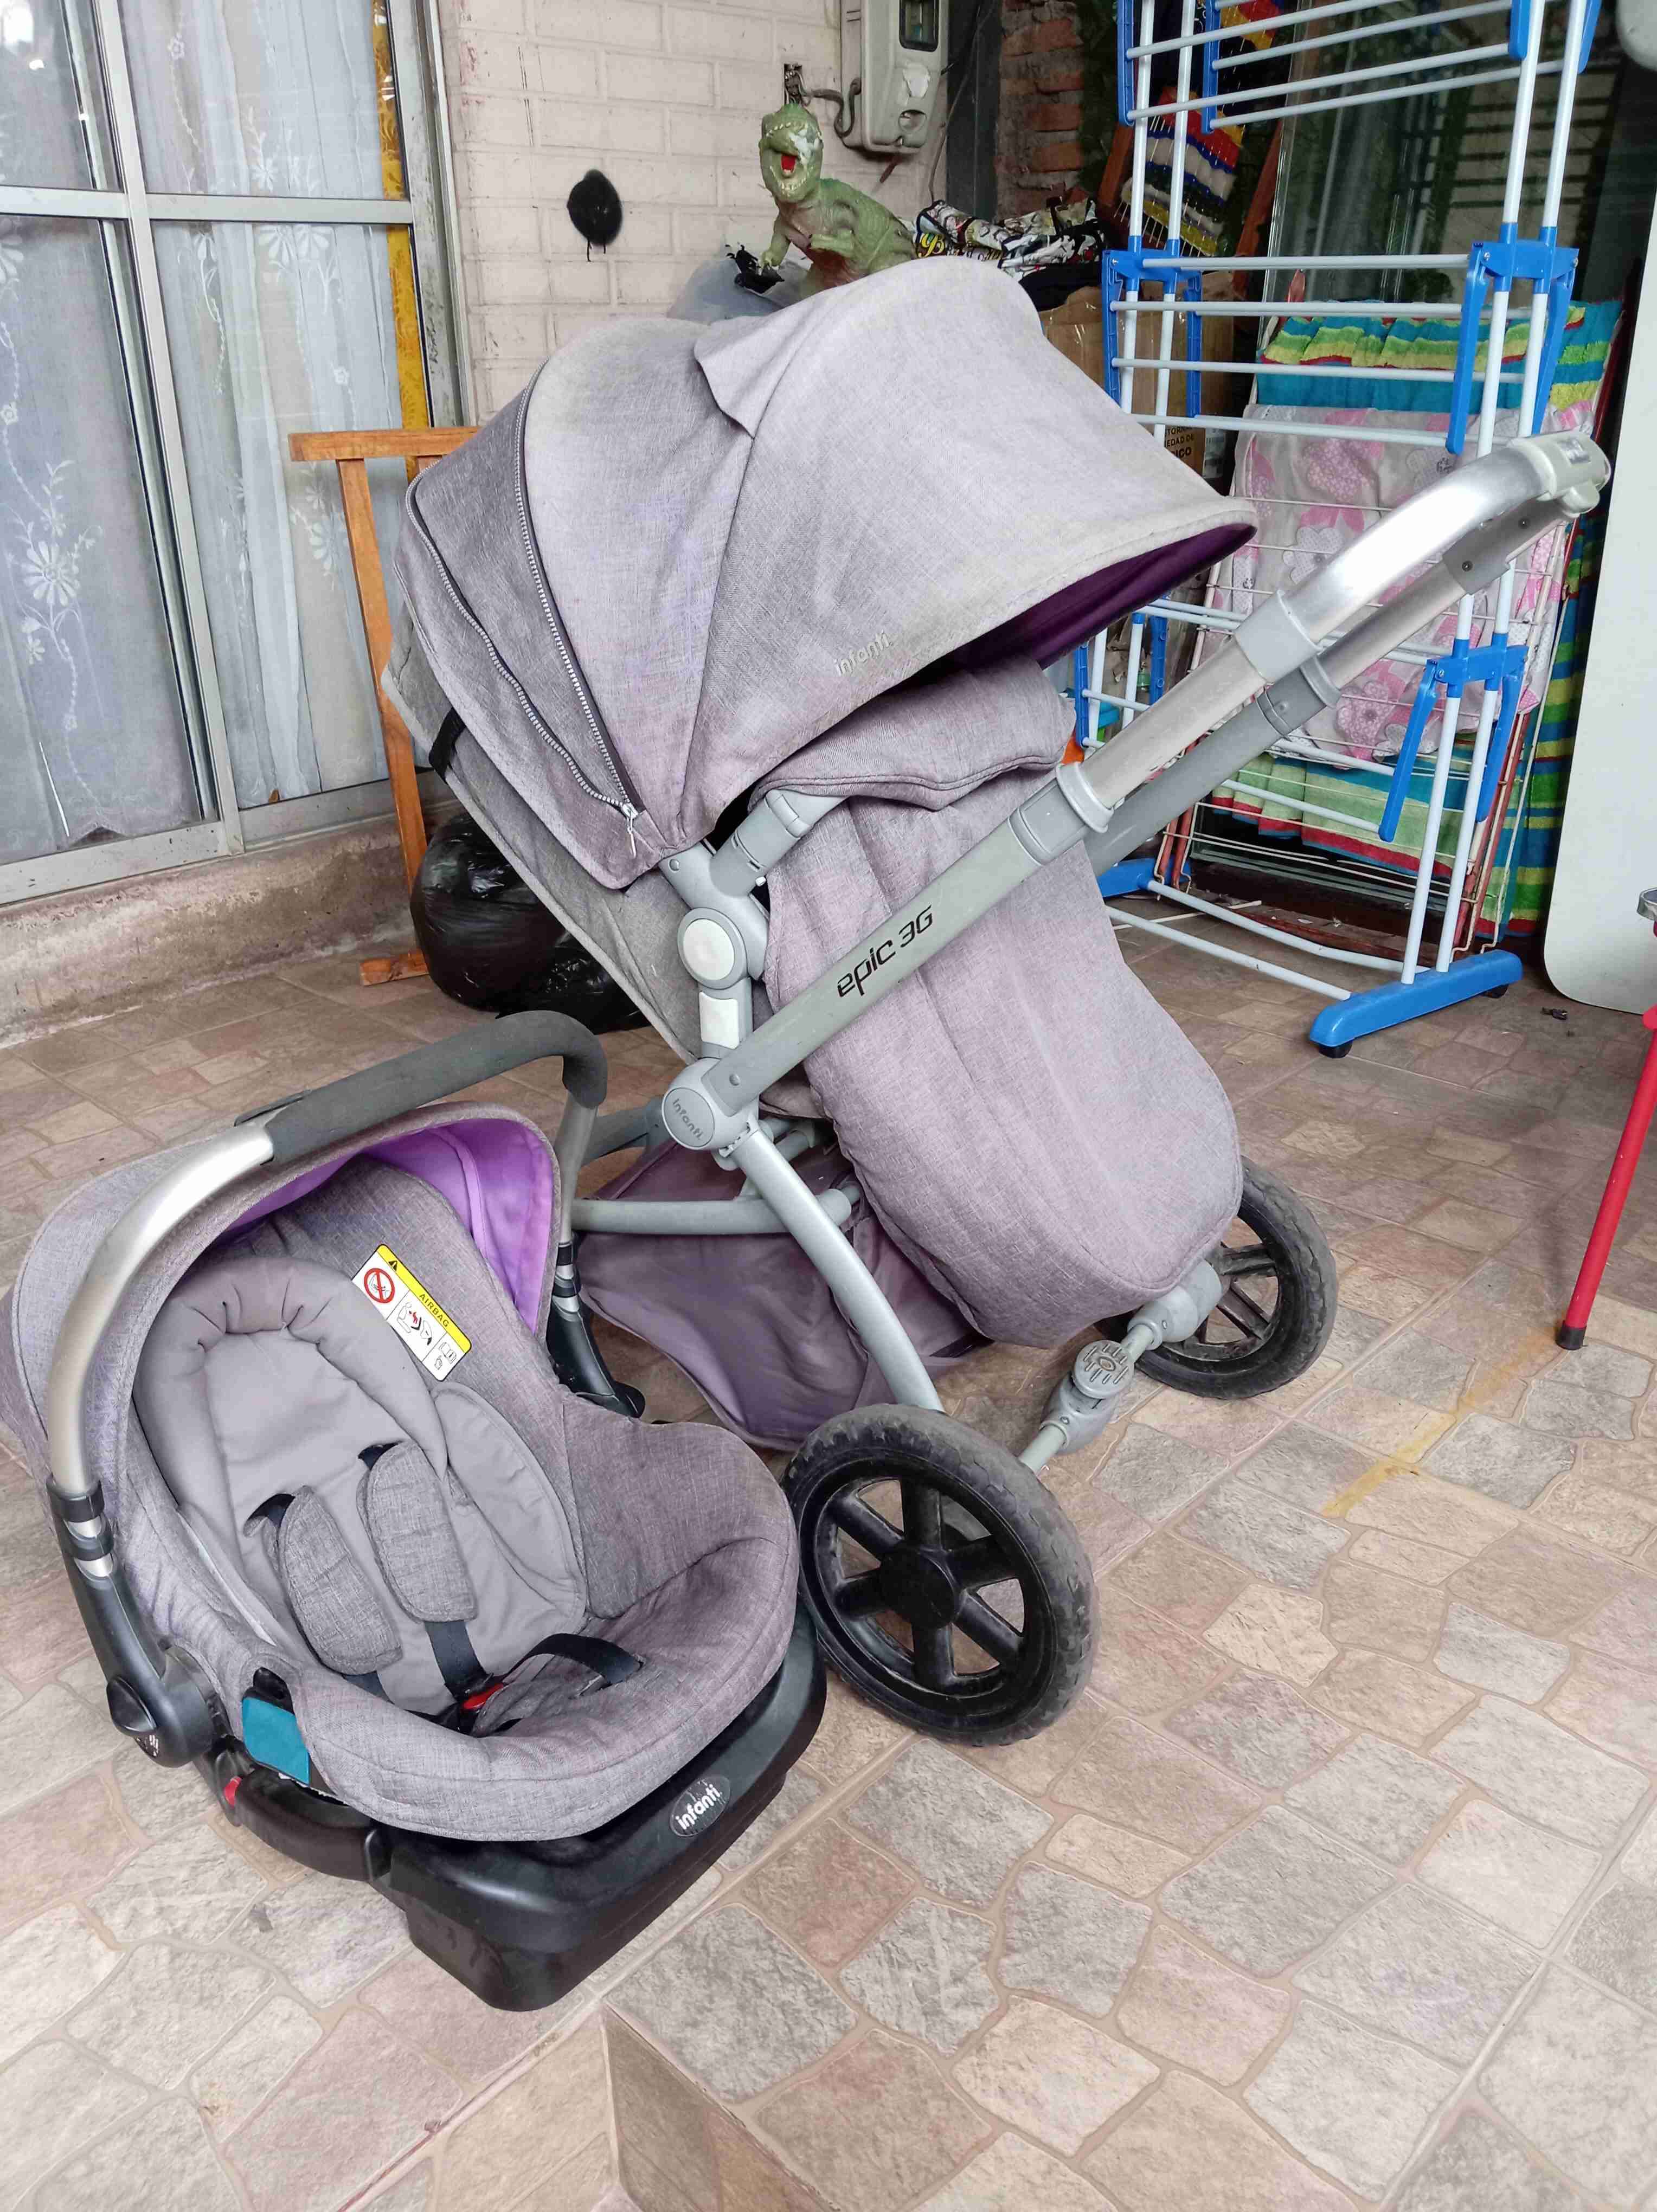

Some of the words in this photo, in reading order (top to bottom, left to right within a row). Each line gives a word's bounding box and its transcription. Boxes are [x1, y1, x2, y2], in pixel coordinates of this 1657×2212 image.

[1167, 436, 1185, 447] EDAD
[833, 628, 890, 677] infanti
[837, 940, 896, 998] epic
[898, 904, 933, 948] 3G
[419, 1294, 449, 1327] AIRBAG
[675, 1784, 721, 1830] infanti
